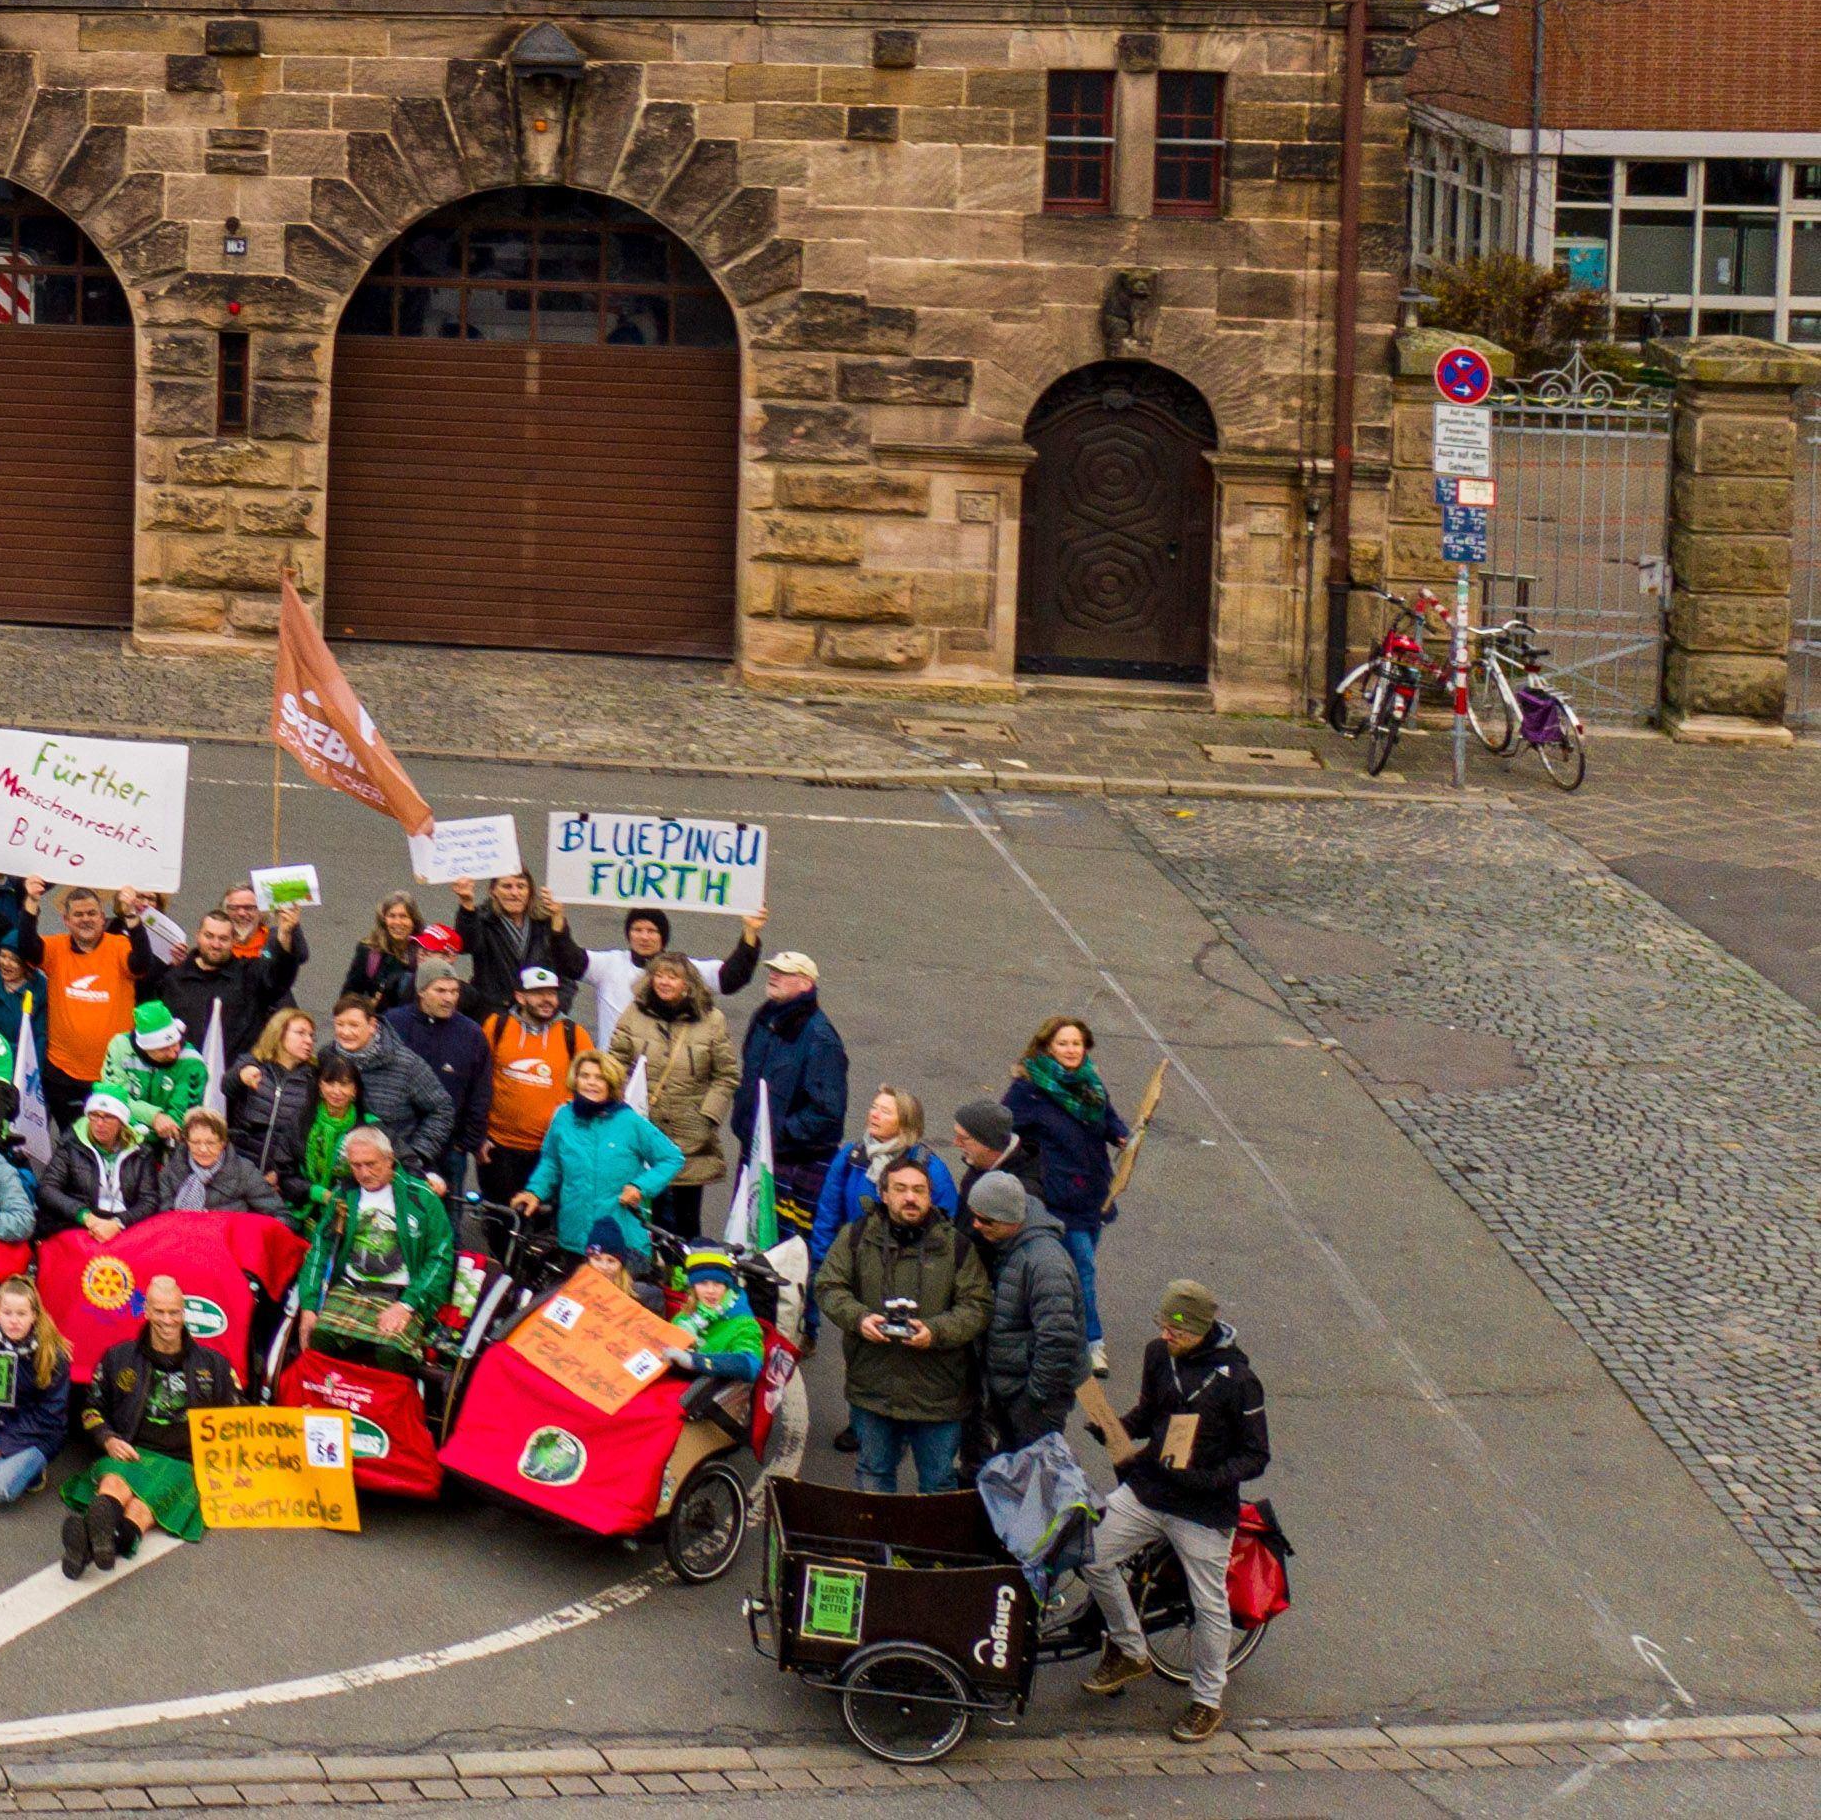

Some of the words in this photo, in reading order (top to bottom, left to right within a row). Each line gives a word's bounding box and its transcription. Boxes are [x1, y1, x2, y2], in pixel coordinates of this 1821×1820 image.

[32, 740, 151, 808] Fürther
[7, 817, 87, 869] Büro
[556, 820, 762, 867] BLUEPINGU
[589, 862, 731, 907] FÜRTH
[818, 1603, 848, 1615] RETTER
[820, 1584, 851, 1595] LEBENS
[820, 1593, 849, 1605] MITTEL
[989, 1585, 1016, 1670] Cangoo
